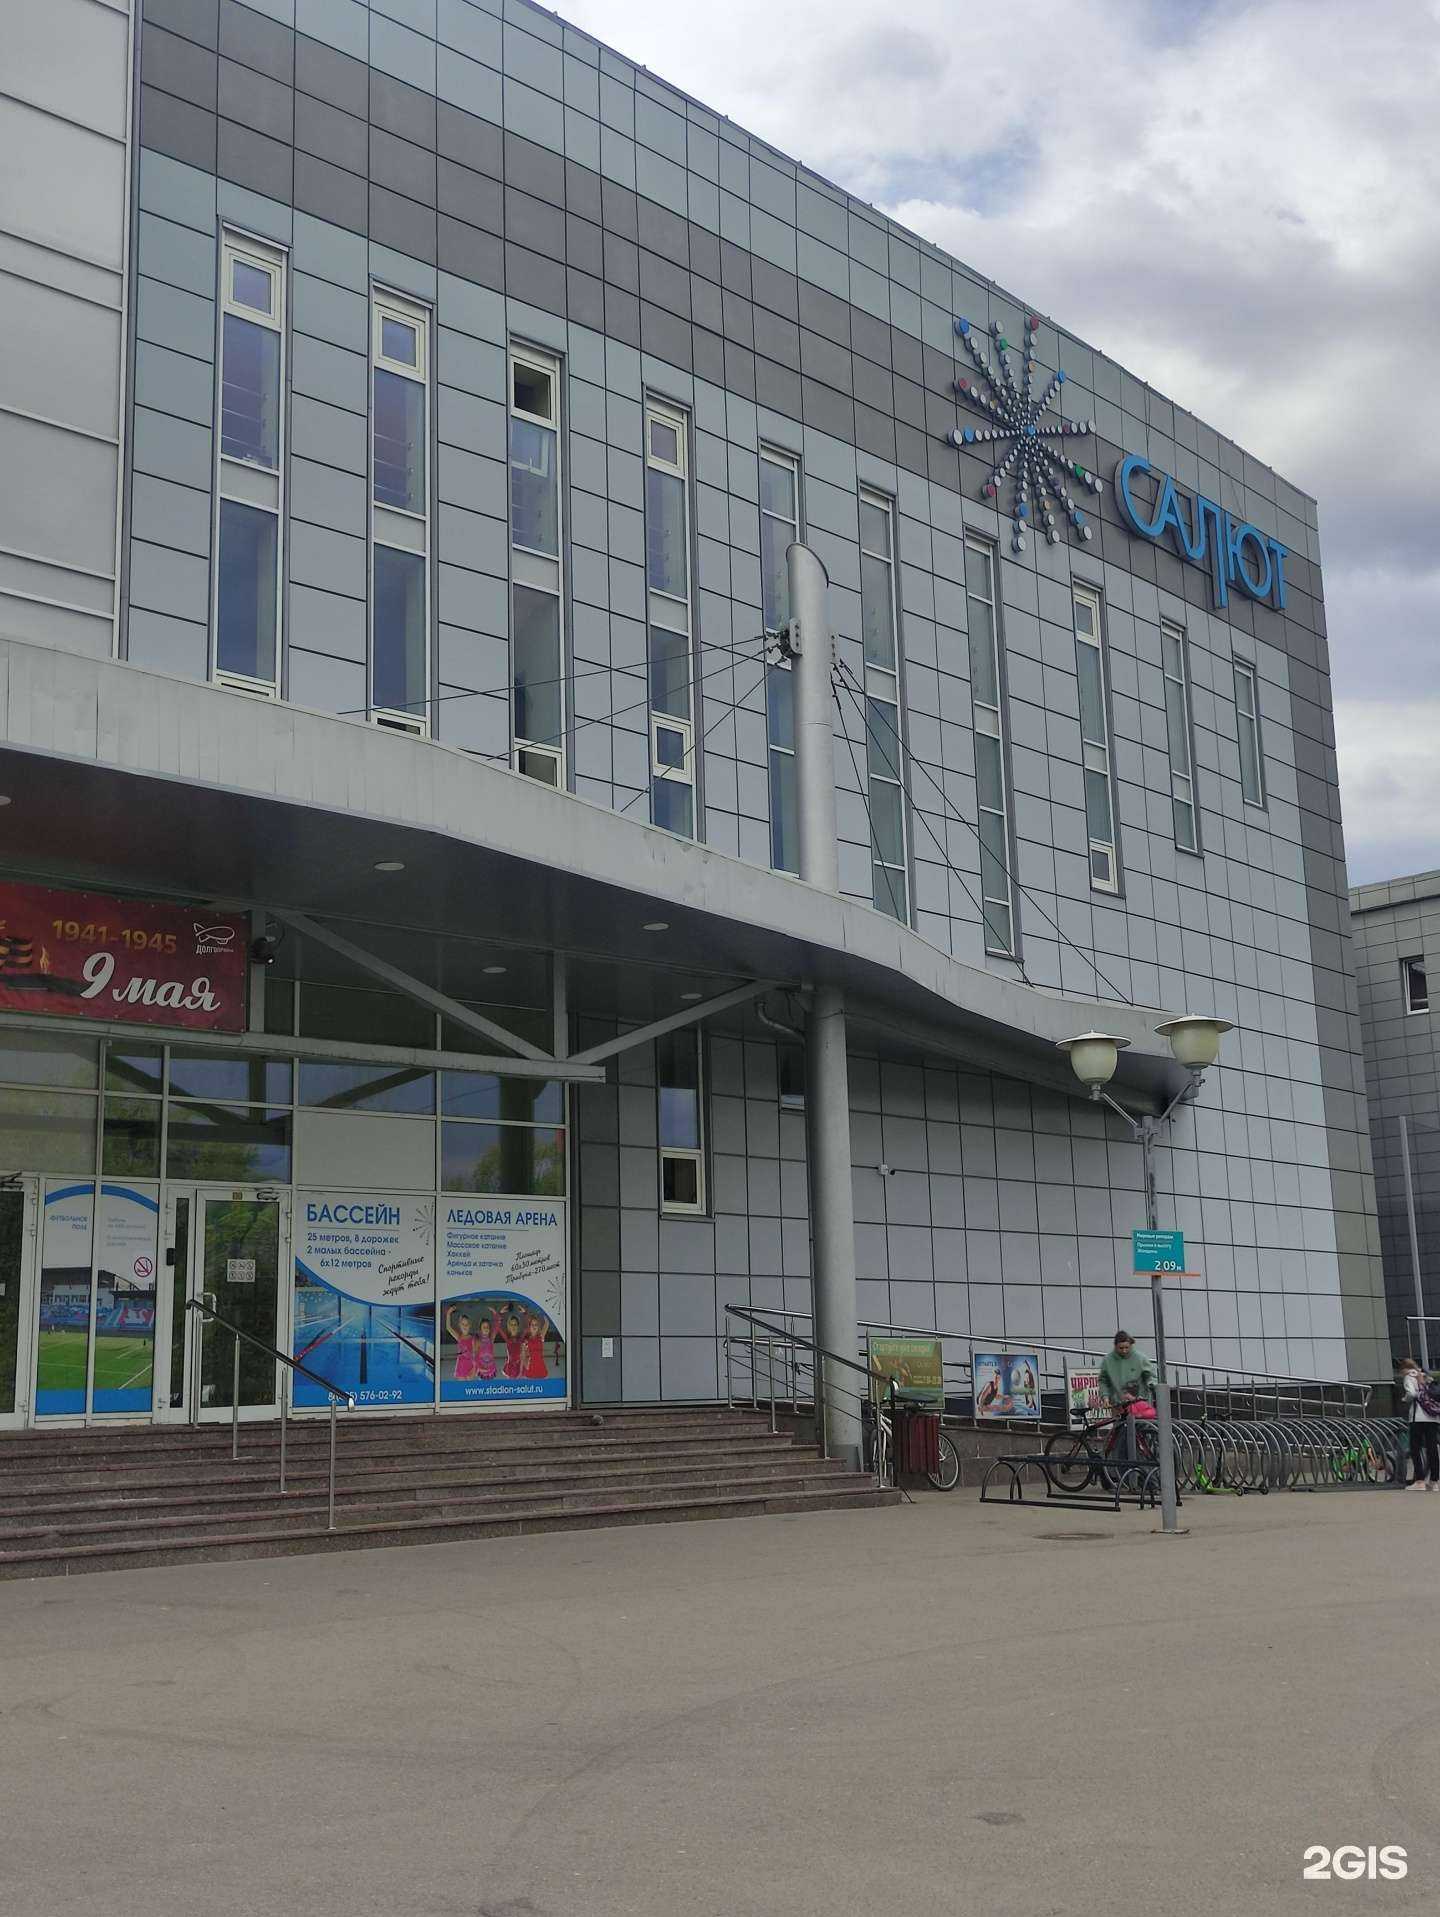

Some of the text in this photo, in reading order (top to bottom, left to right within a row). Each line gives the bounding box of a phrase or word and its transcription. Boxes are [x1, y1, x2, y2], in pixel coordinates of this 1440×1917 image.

[1115, 454, 1289, 610] САЛЮТ
[52, 919, 177, 953] 1941-1945
[80, 952, 220, 1012] 9 мая
[307, 1203, 400, 1226] БАССЕЙН
[447, 1209, 558, 1227] ЛЕДОВАЯ АРЕНА
[307, 1232, 317, 1241] 25
[307, 1245, 312, 1254] 2
[360, 1389, 402, 1401] 576-02-92
